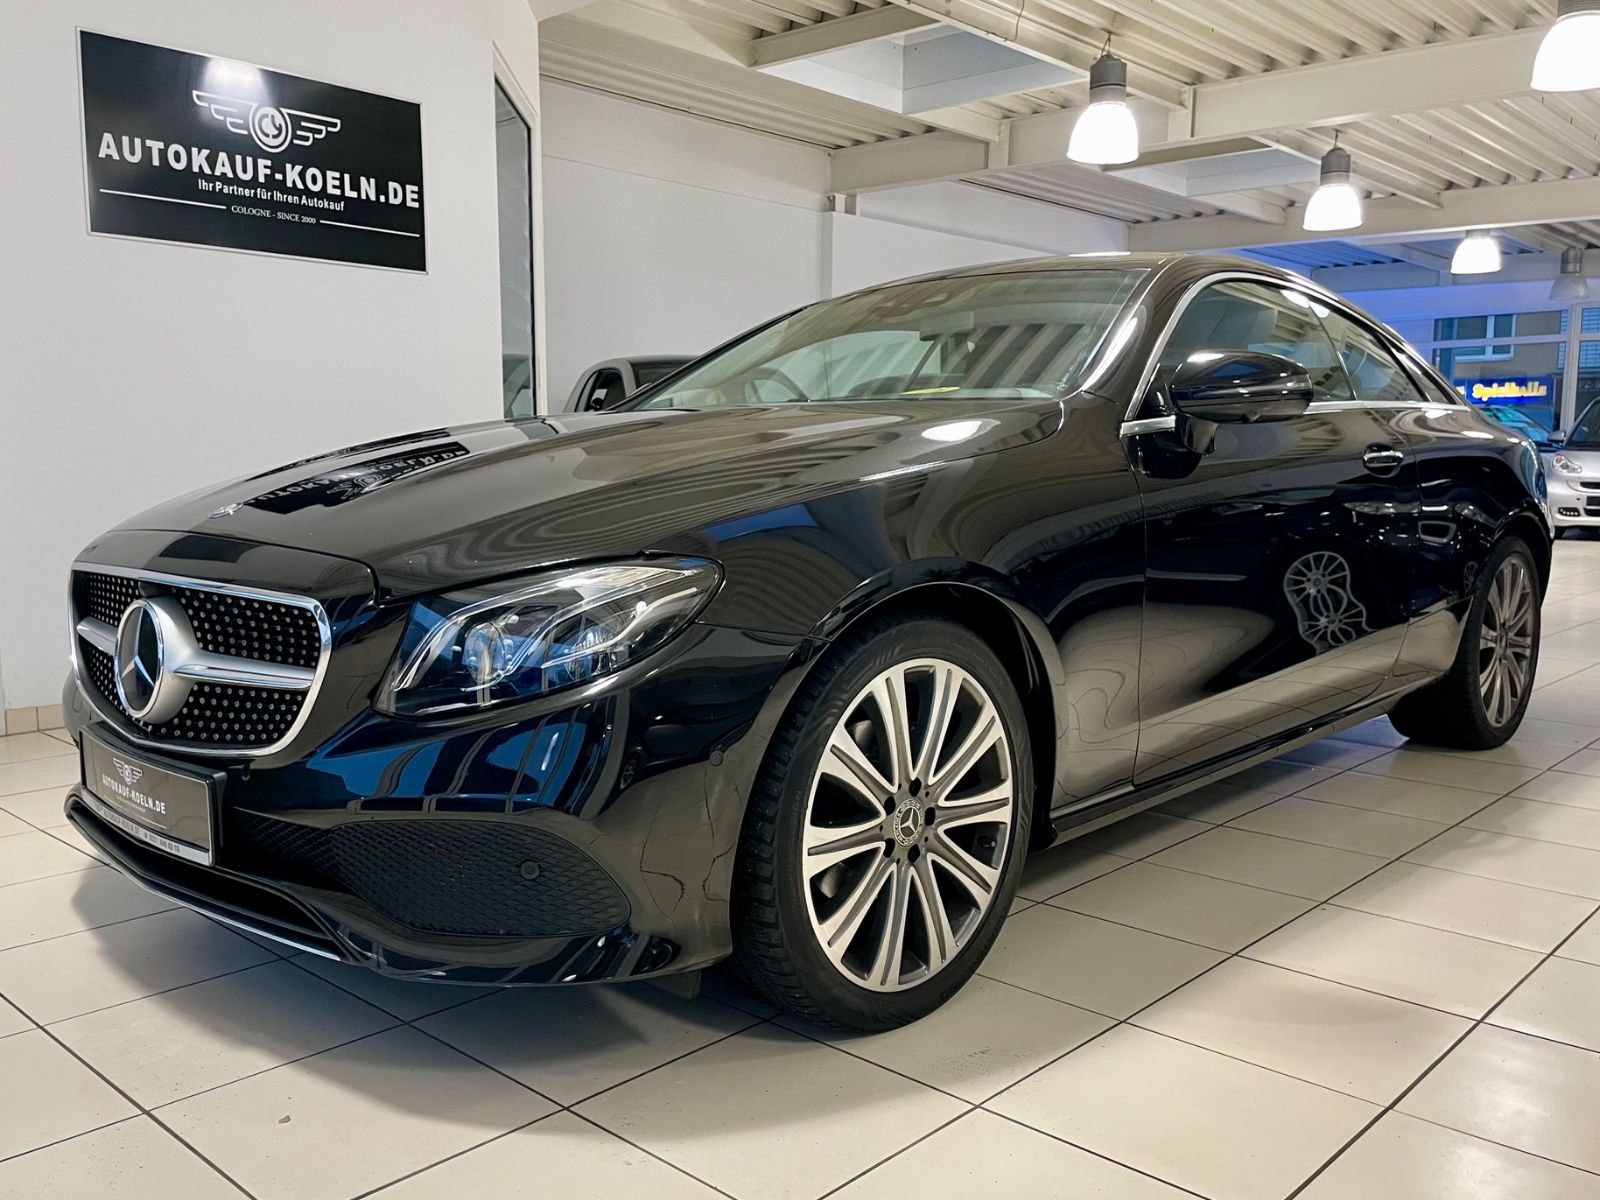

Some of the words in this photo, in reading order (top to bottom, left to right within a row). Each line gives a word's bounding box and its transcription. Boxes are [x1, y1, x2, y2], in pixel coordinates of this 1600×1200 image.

[98, 132, 420, 208] AUTOKAUF-KOELN.DE
[198, 178, 214, 192] Ihr
[215, 181, 254, 198] Partner
[257, 187, 272, 201] für
[273, 190, 300, 205] Ihren
[301, 194, 345, 212] Autokauf
[231, 204, 271, 218] COLOGNE
[276, 211, 299, 222] SINCE
[301, 215, 317, 224] 2000
[102, 774, 166, 815] AUTOKAUF-KOELN.DE
